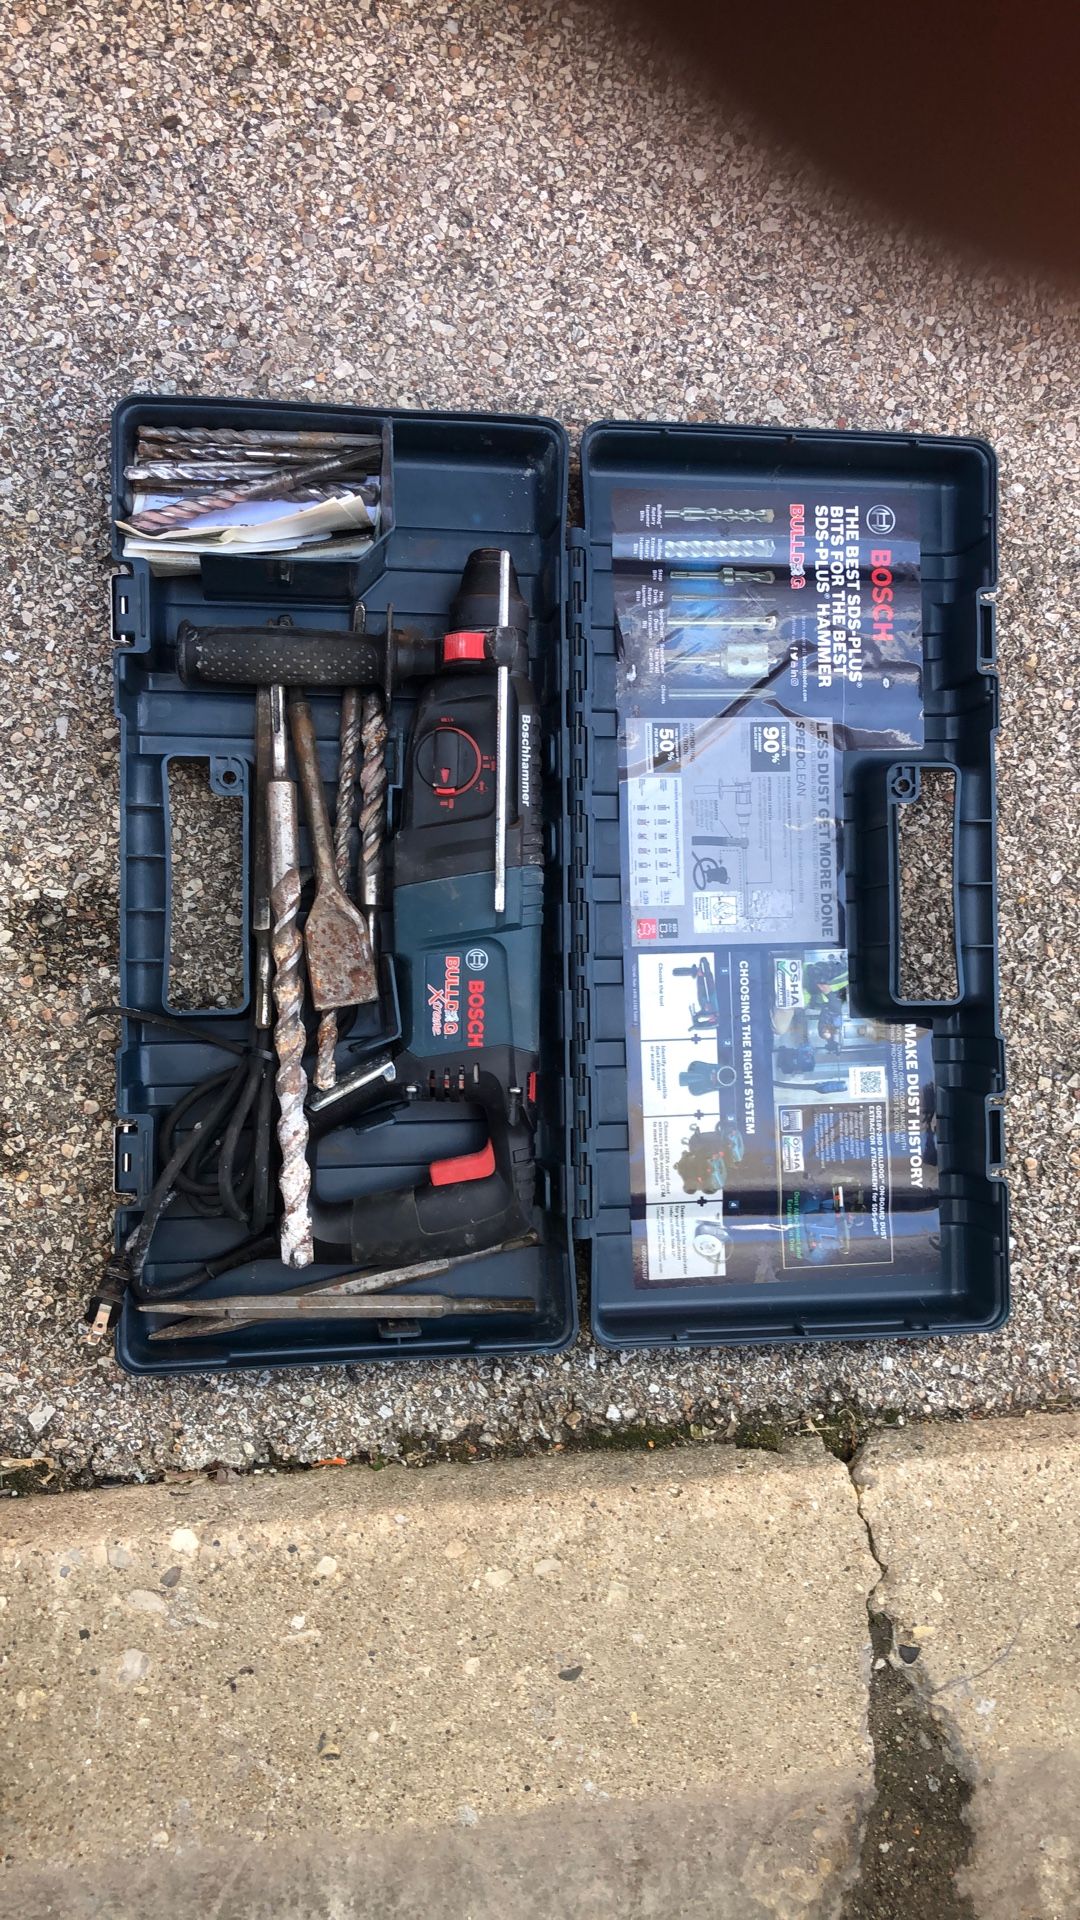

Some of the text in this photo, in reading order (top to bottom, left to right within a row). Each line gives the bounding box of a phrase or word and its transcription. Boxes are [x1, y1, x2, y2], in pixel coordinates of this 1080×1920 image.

[789, 504, 806, 590] BULLDG
[846, 506, 859, 540] THE
[830, 506, 847, 675] BITS FOR THE BEST
[846, 546, 860, 590] BEST
[871, 550, 894, 640] BOSCH
[817, 604, 831, 687] HAMMER
[521, 714, 531, 807] Boschhammer
[659, 728, 675, 760] 50%
[816, 723, 833, 937] LESS DUST GET MORE DONE
[428, 984, 448, 1036] Xtreme
[444, 956, 460, 1034] BULLDG
[467, 980, 485, 1047] BOSCH
[790, 961, 799, 1006] OSHA
[739, 960, 755, 1134] CHOOSING THE RIGHT SYSTEM
[905, 1024, 923, 1188] MAKE DUST HISTORY
[870, 1147, 878, 1191] ATTACHMENT
